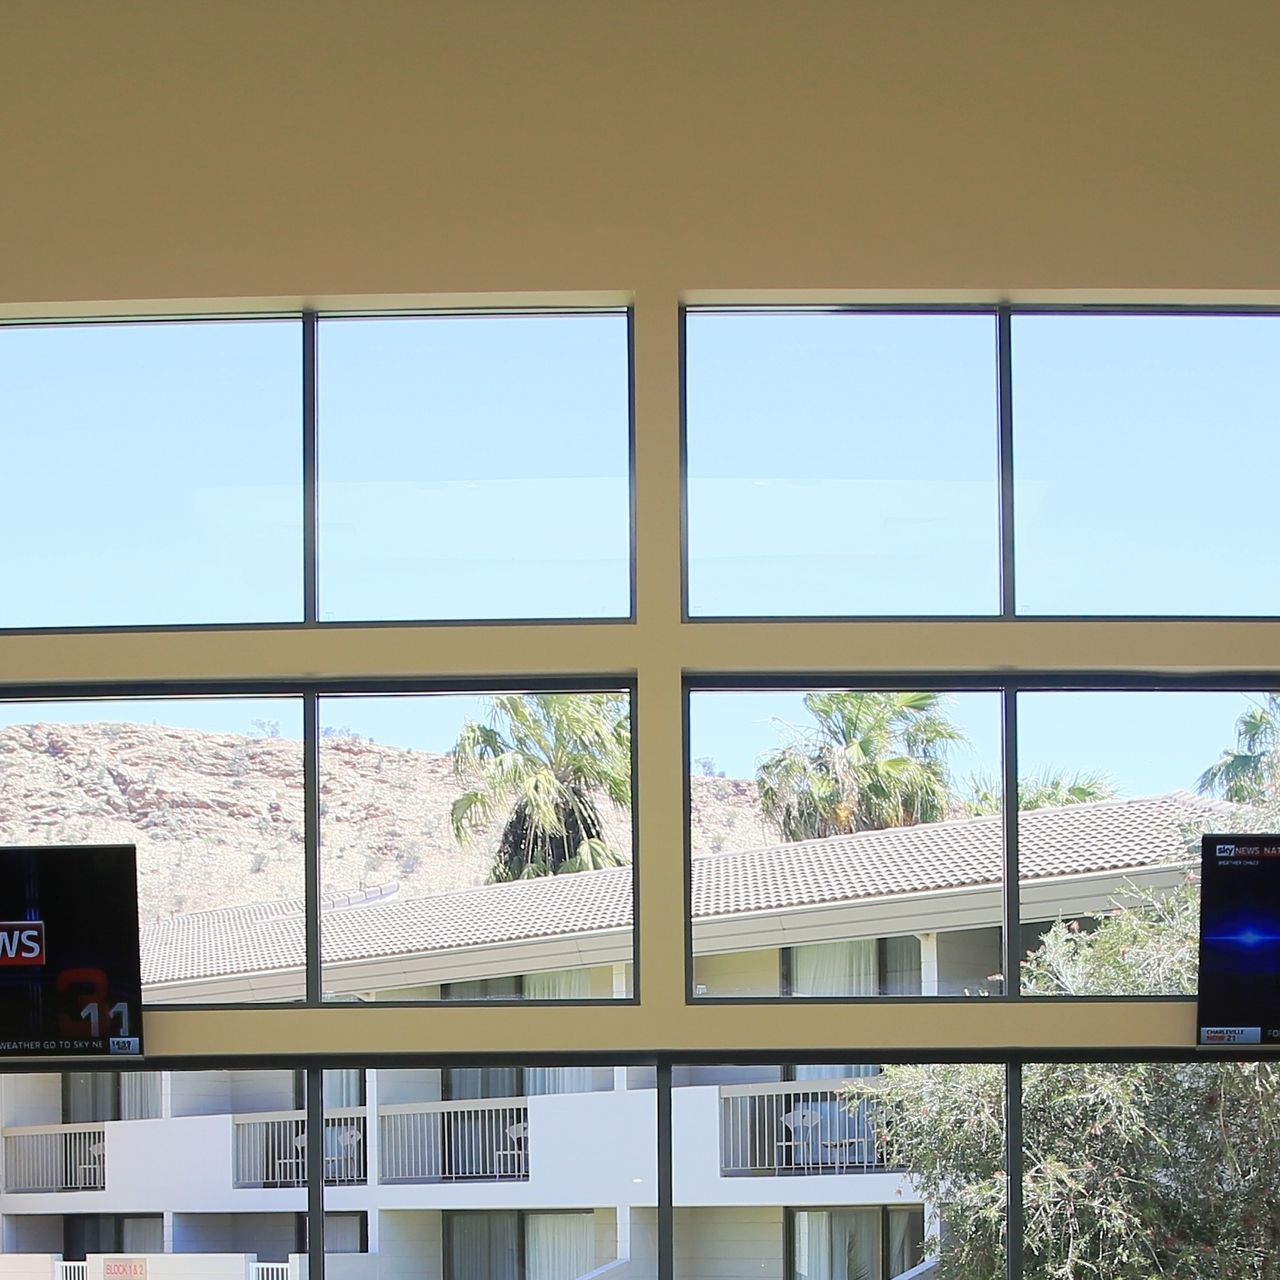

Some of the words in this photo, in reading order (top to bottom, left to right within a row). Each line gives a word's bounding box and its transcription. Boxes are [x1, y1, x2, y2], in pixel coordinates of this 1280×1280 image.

[1217, 845, 1234, 856] sky
[43, 1041, 56, 1049] GO
[59, 1041, 71, 1049] TO
[106, 1263, 128, 1275] BLOCK
[133, 1263, 139, 1275] &
[139, 1263, 144, 1275] 2
